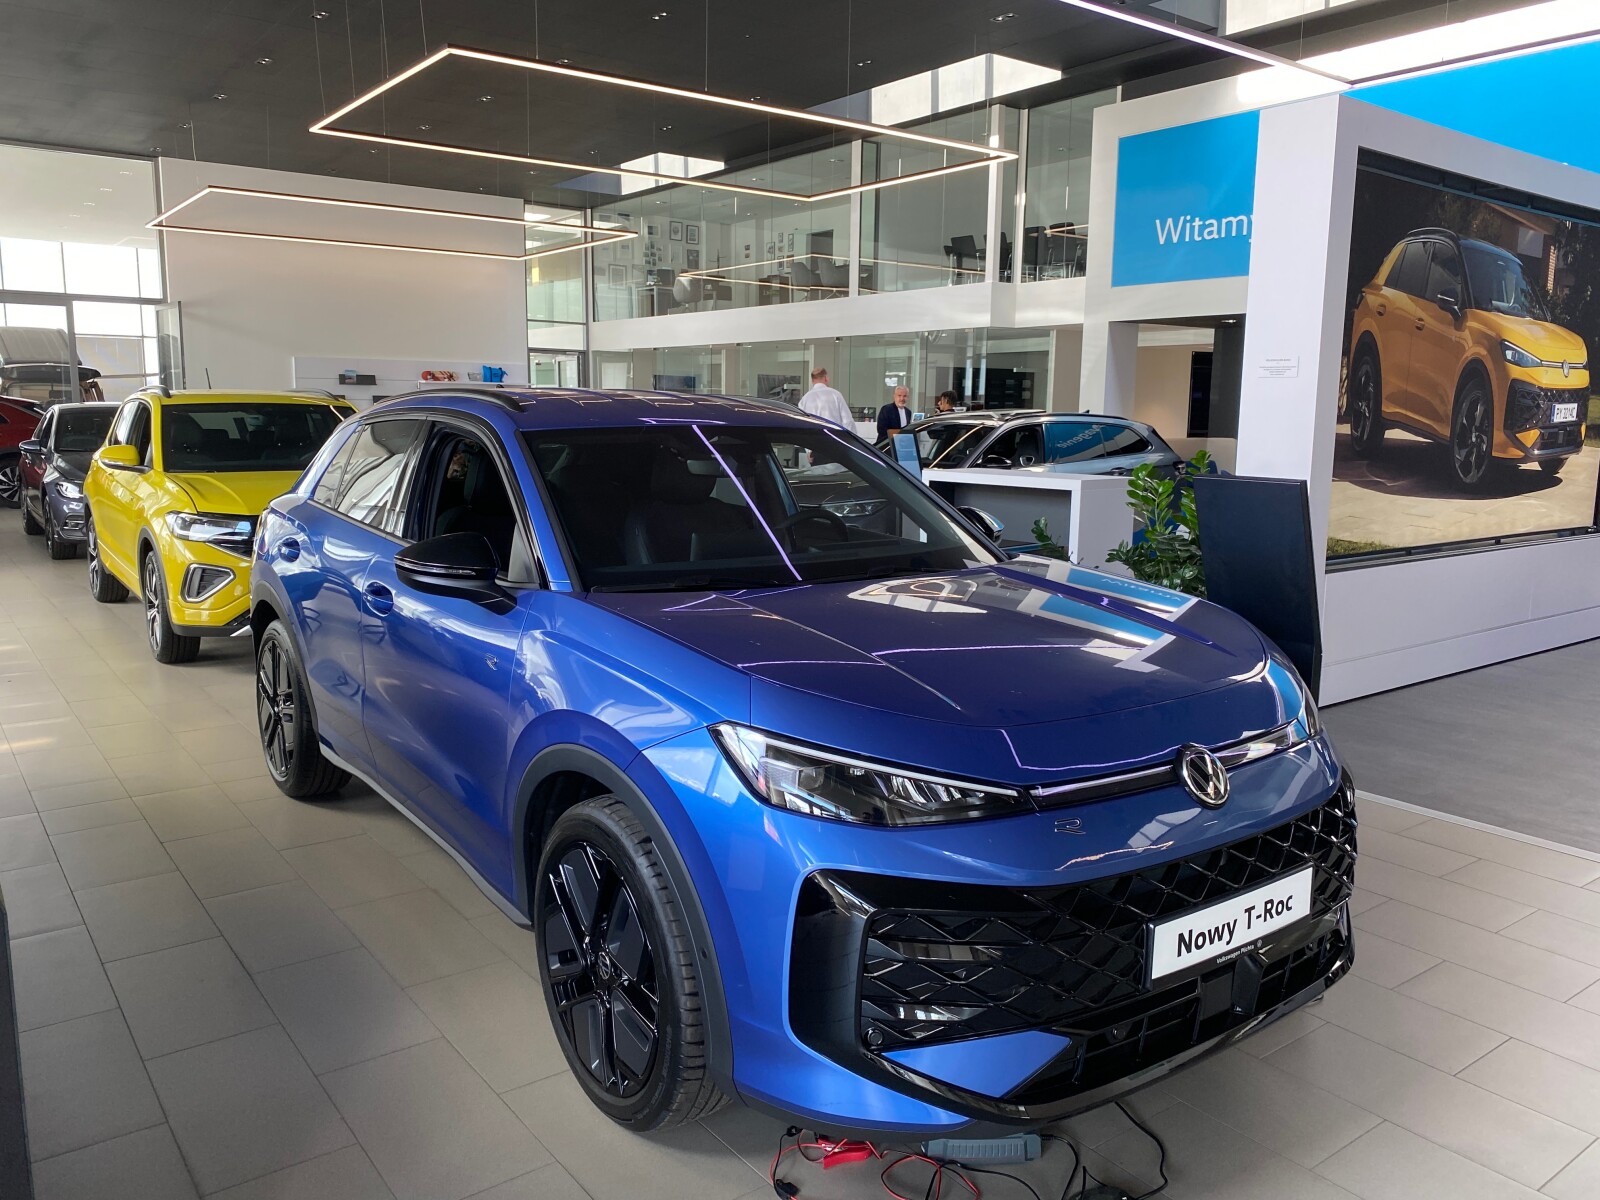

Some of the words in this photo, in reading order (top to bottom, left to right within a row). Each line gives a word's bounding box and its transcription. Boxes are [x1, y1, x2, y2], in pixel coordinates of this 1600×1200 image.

[1155, 214, 1254, 245] Witam
[1177, 918, 1238, 958] Nowy
[1244, 894, 1294, 930] T-Roc
